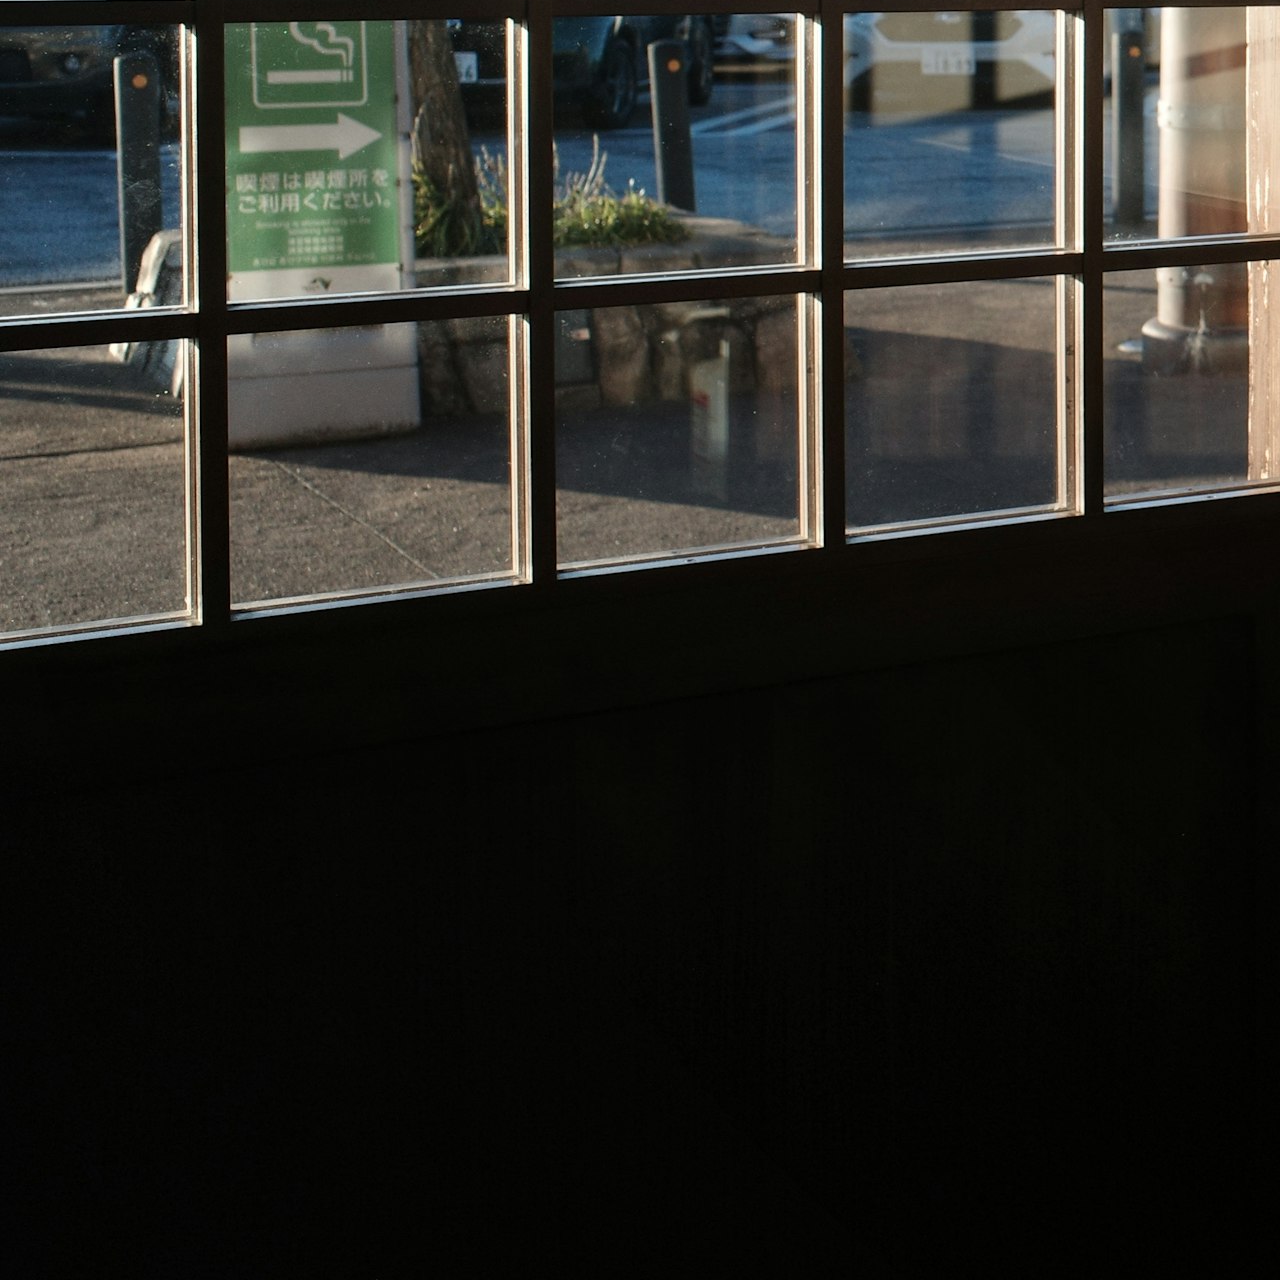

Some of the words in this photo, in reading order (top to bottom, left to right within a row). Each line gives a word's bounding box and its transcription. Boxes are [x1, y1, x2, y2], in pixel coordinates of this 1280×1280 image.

[236, 170, 389, 192] 喫煙は喫煙所を
[238, 192, 391, 213] ご利用ください。
